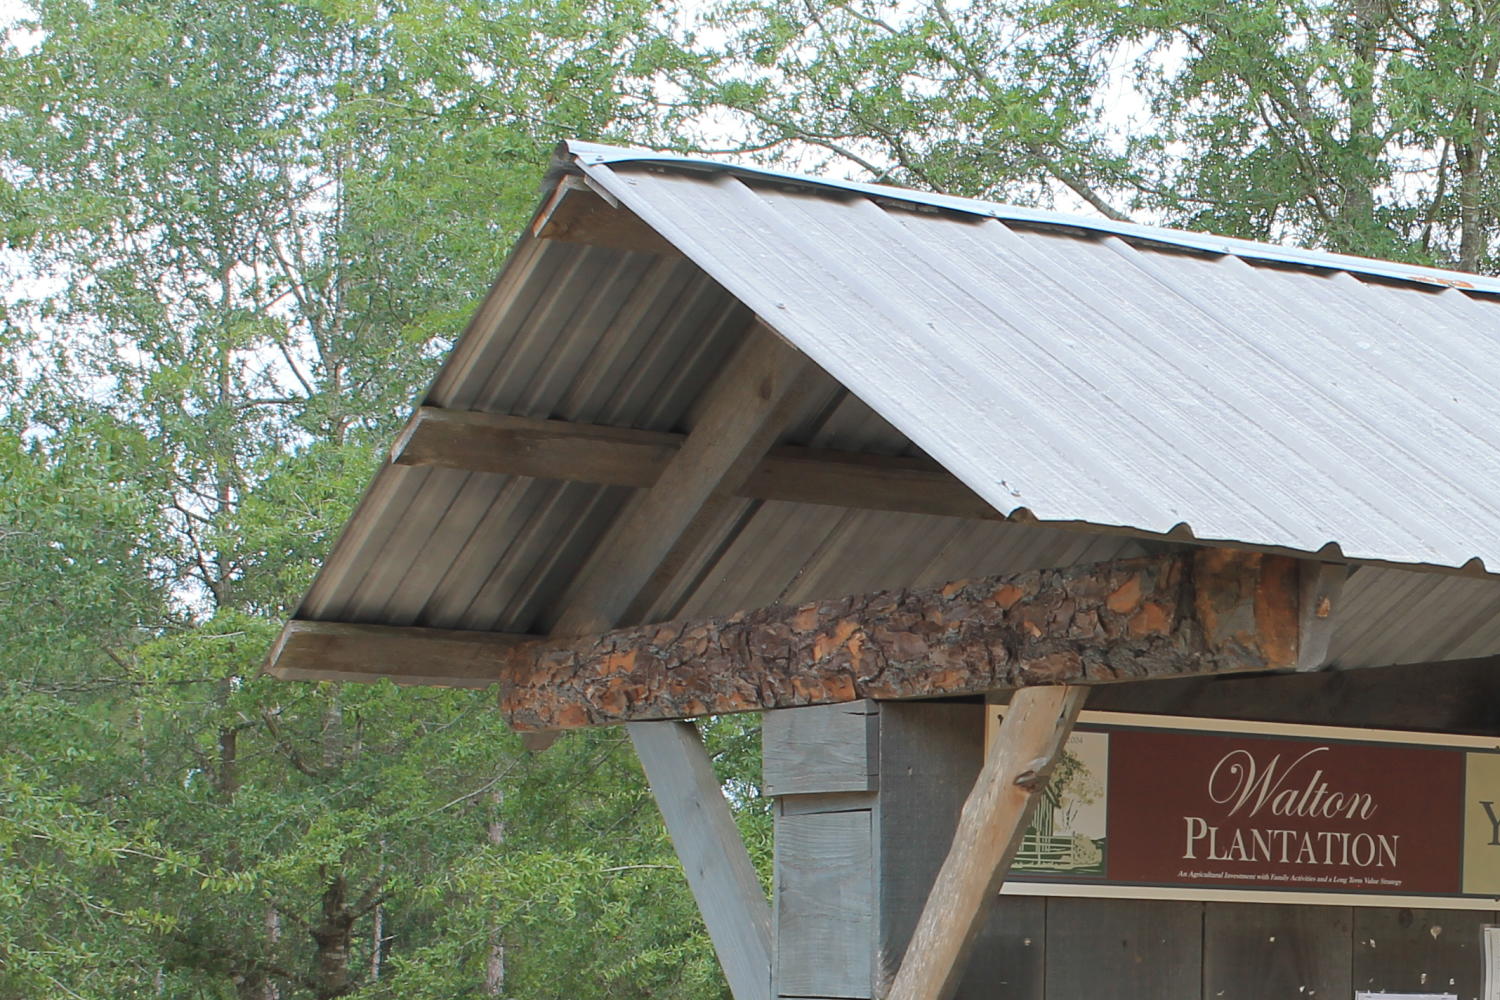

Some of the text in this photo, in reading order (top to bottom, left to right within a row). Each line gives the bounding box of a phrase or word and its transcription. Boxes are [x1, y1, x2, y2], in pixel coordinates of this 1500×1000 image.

[1209, 747, 1378, 819] Walton
[1182, 816, 1400, 867] PLANTATION
[1189, 871, 1224, 879] Agricultural
[1224, 872, 1256, 880] Investment
[1256, 873, 1269, 881] with
[1270, 873, 1290, 882] Family
[1333, 876, 1348, 884] Long
[1364, 877, 1380, 885] Value
